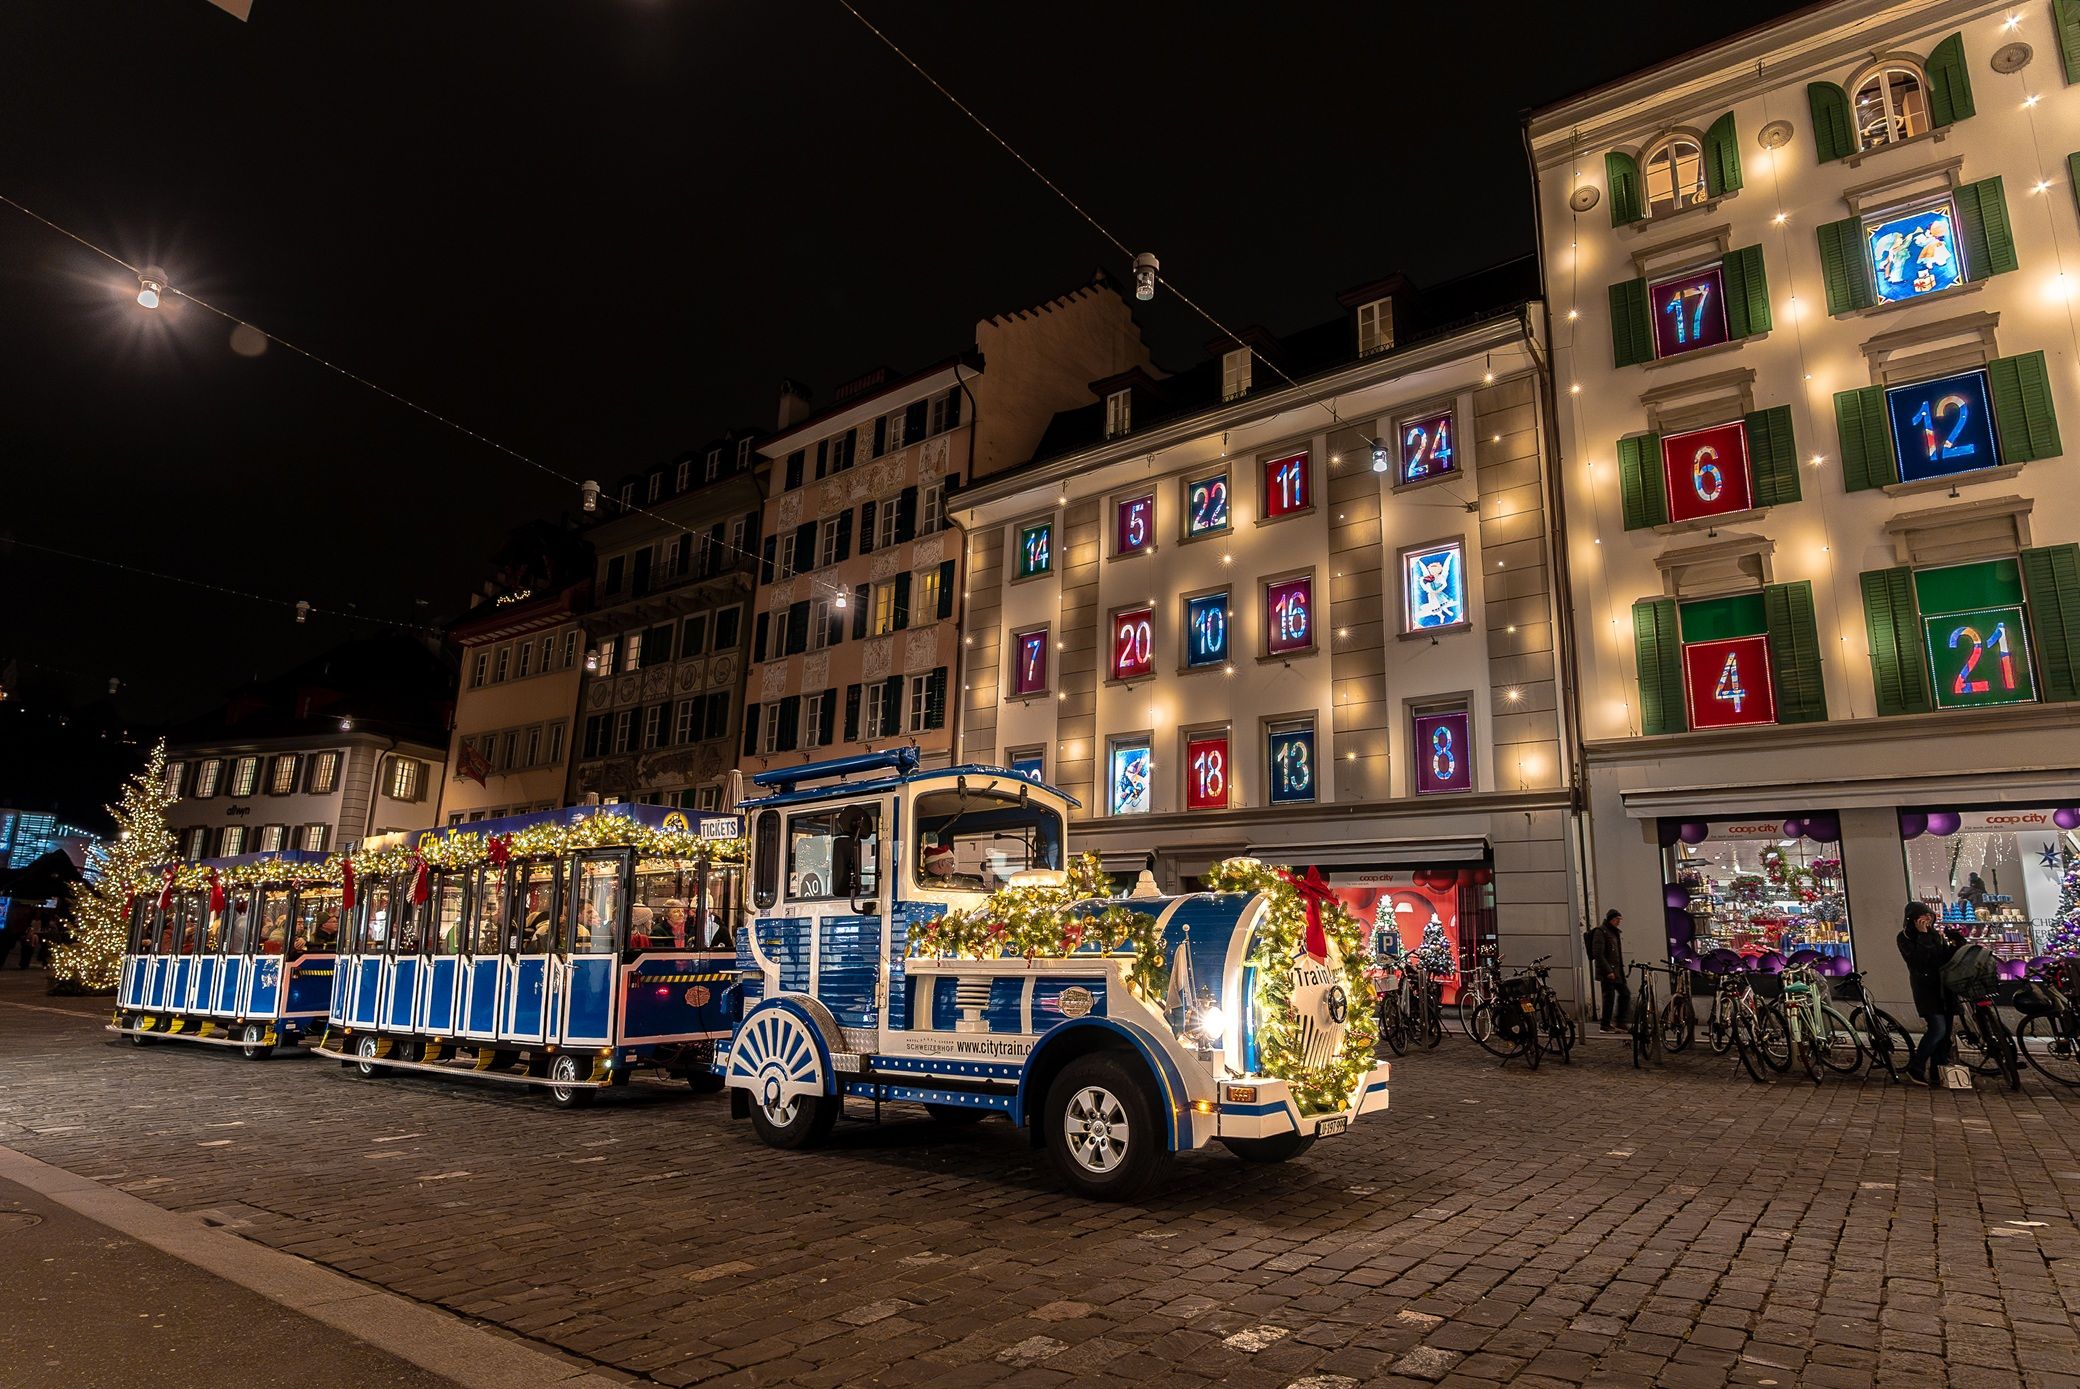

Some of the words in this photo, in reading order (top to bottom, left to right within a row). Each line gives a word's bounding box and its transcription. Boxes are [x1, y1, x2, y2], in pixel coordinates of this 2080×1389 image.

[1665, 284, 1709, 343] 17
[1407, 421, 1451, 478] 24
[1912, 395, 1975, 461] 12
[1276, 461, 1301, 509] 11
[1693, 446, 1722, 501] 6
[1128, 504, 1145, 545] 5
[1194, 483, 1227, 530] 22
[1026, 530, 1050, 571] 14
[1196, 607, 1223, 653] 10
[1276, 592, 1306, 640] 16
[1027, 640, 1040, 681] 7
[1120, 621, 1151, 668] 20
[1949, 623, 2016, 694] 21
[1716, 652, 1746, 713] 4
[1194, 751, 1223, 799] 18
[1278, 742, 1309, 795] 13
[1433, 726, 1454, 780] 8
[701, 821, 737, 837] TICKETS
[1729, 826, 1756, 834] coop
[1758, 824, 1778, 833] city
[1986, 816, 2020, 824] coop
[2022, 813, 2047, 824] city
[1380, 874, 1393, 882] city
[1382, 935, 1393, 951] P
[907, 1043, 954, 1052] SCHWEIZERHOF
